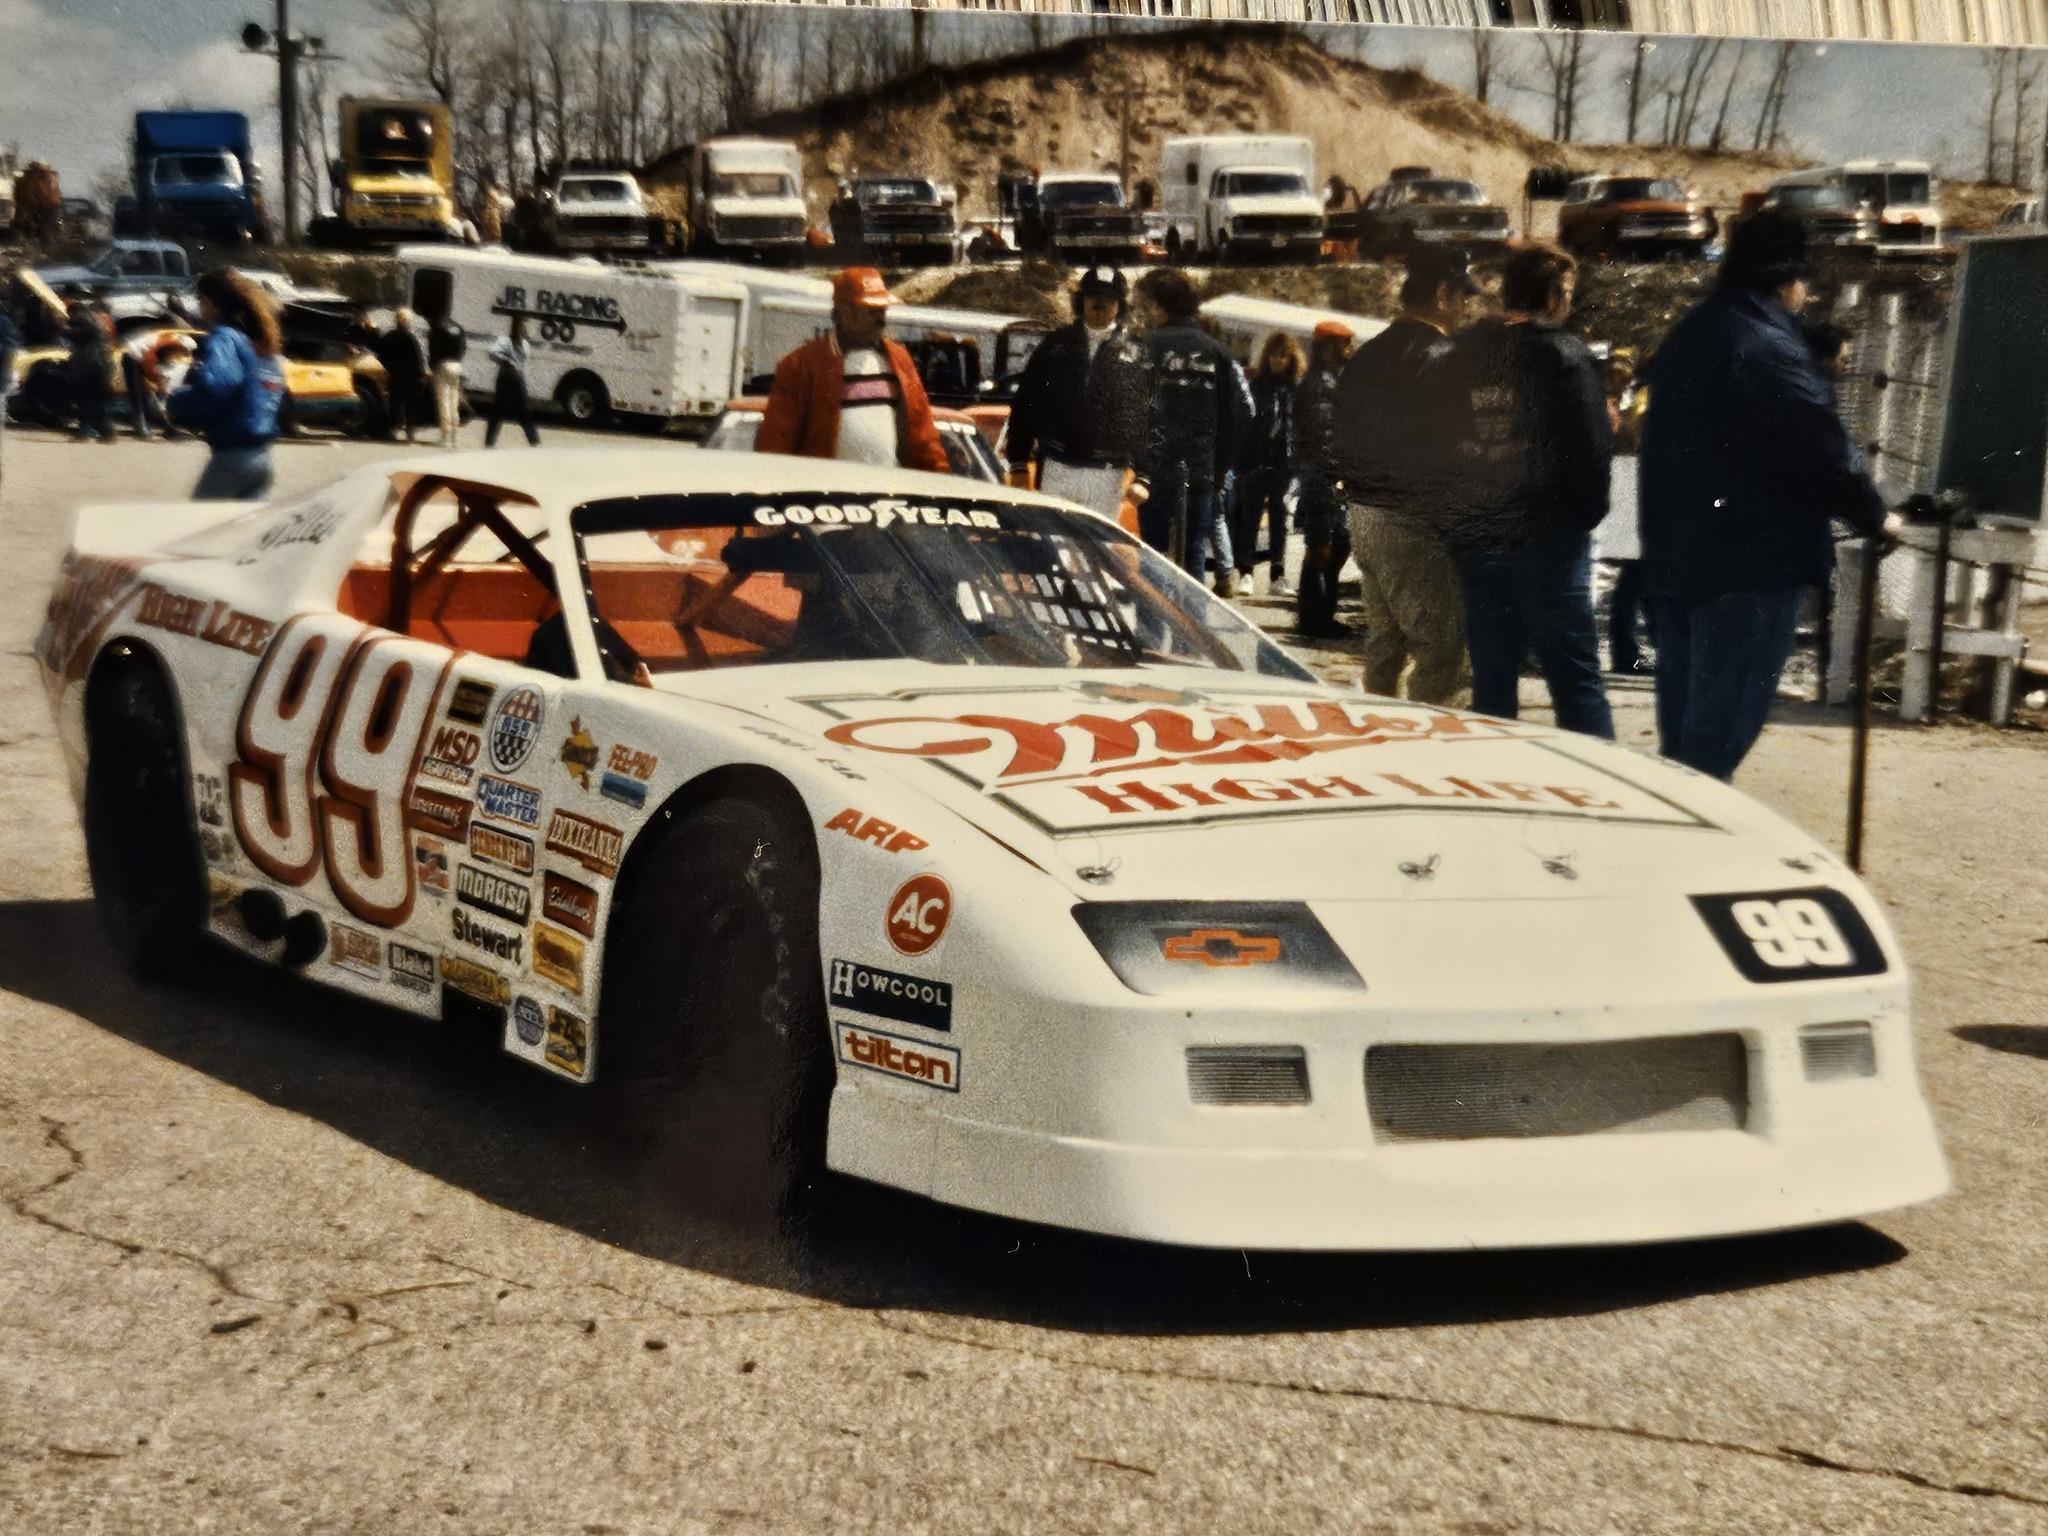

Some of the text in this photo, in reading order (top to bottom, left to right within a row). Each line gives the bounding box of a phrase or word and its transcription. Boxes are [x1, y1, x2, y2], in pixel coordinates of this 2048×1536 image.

[537, 290, 619, 319] RACING
[754, 500, 1000, 529] GOODYEAR
[430, 726, 482, 766] MSD
[824, 702, 1518, 777] Miller
[229, 612, 459, 929] 99
[1067, 773, 1622, 812] HIGH LIFE
[824, 808, 929, 853] ARP
[452, 907, 522, 965] Stewart
[892, 892, 945, 935] AC
[1731, 898, 1851, 968] 99
[832, 961, 948, 1007] HOWCOOL
[845, 1031, 951, 1084] tilton
